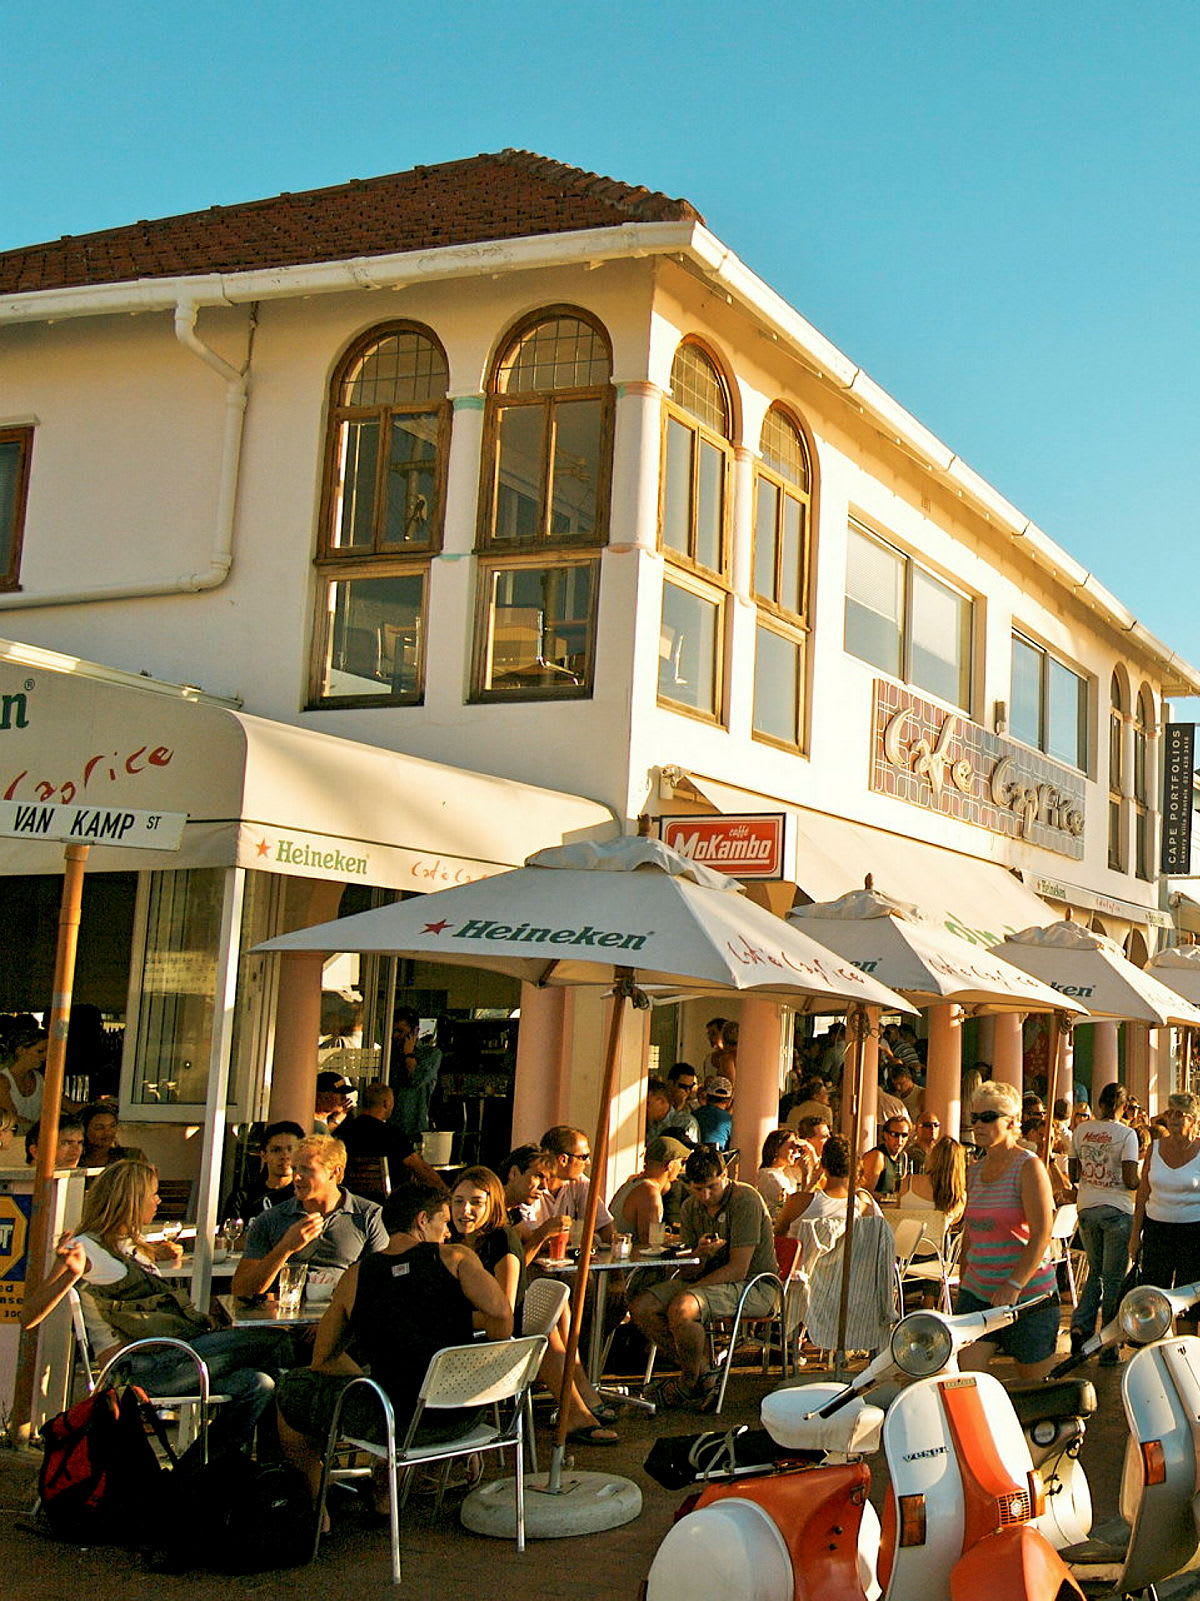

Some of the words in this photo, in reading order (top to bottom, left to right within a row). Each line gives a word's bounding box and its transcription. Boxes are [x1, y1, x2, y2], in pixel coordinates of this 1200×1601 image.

[1169, 729, 1181, 821] PORTFOLIOS
[991, 755, 1085, 838] Caprice
[13, 805, 55, 833] VAN
[70, 810, 135, 839] KAMP
[146, 816, 161, 830] ST
[275, 840, 368, 875] Heineken
[674, 832, 772, 859] MoKambo
[1168, 828, 1178, 864] CAPE
[452, 919, 650, 950] Heineken
